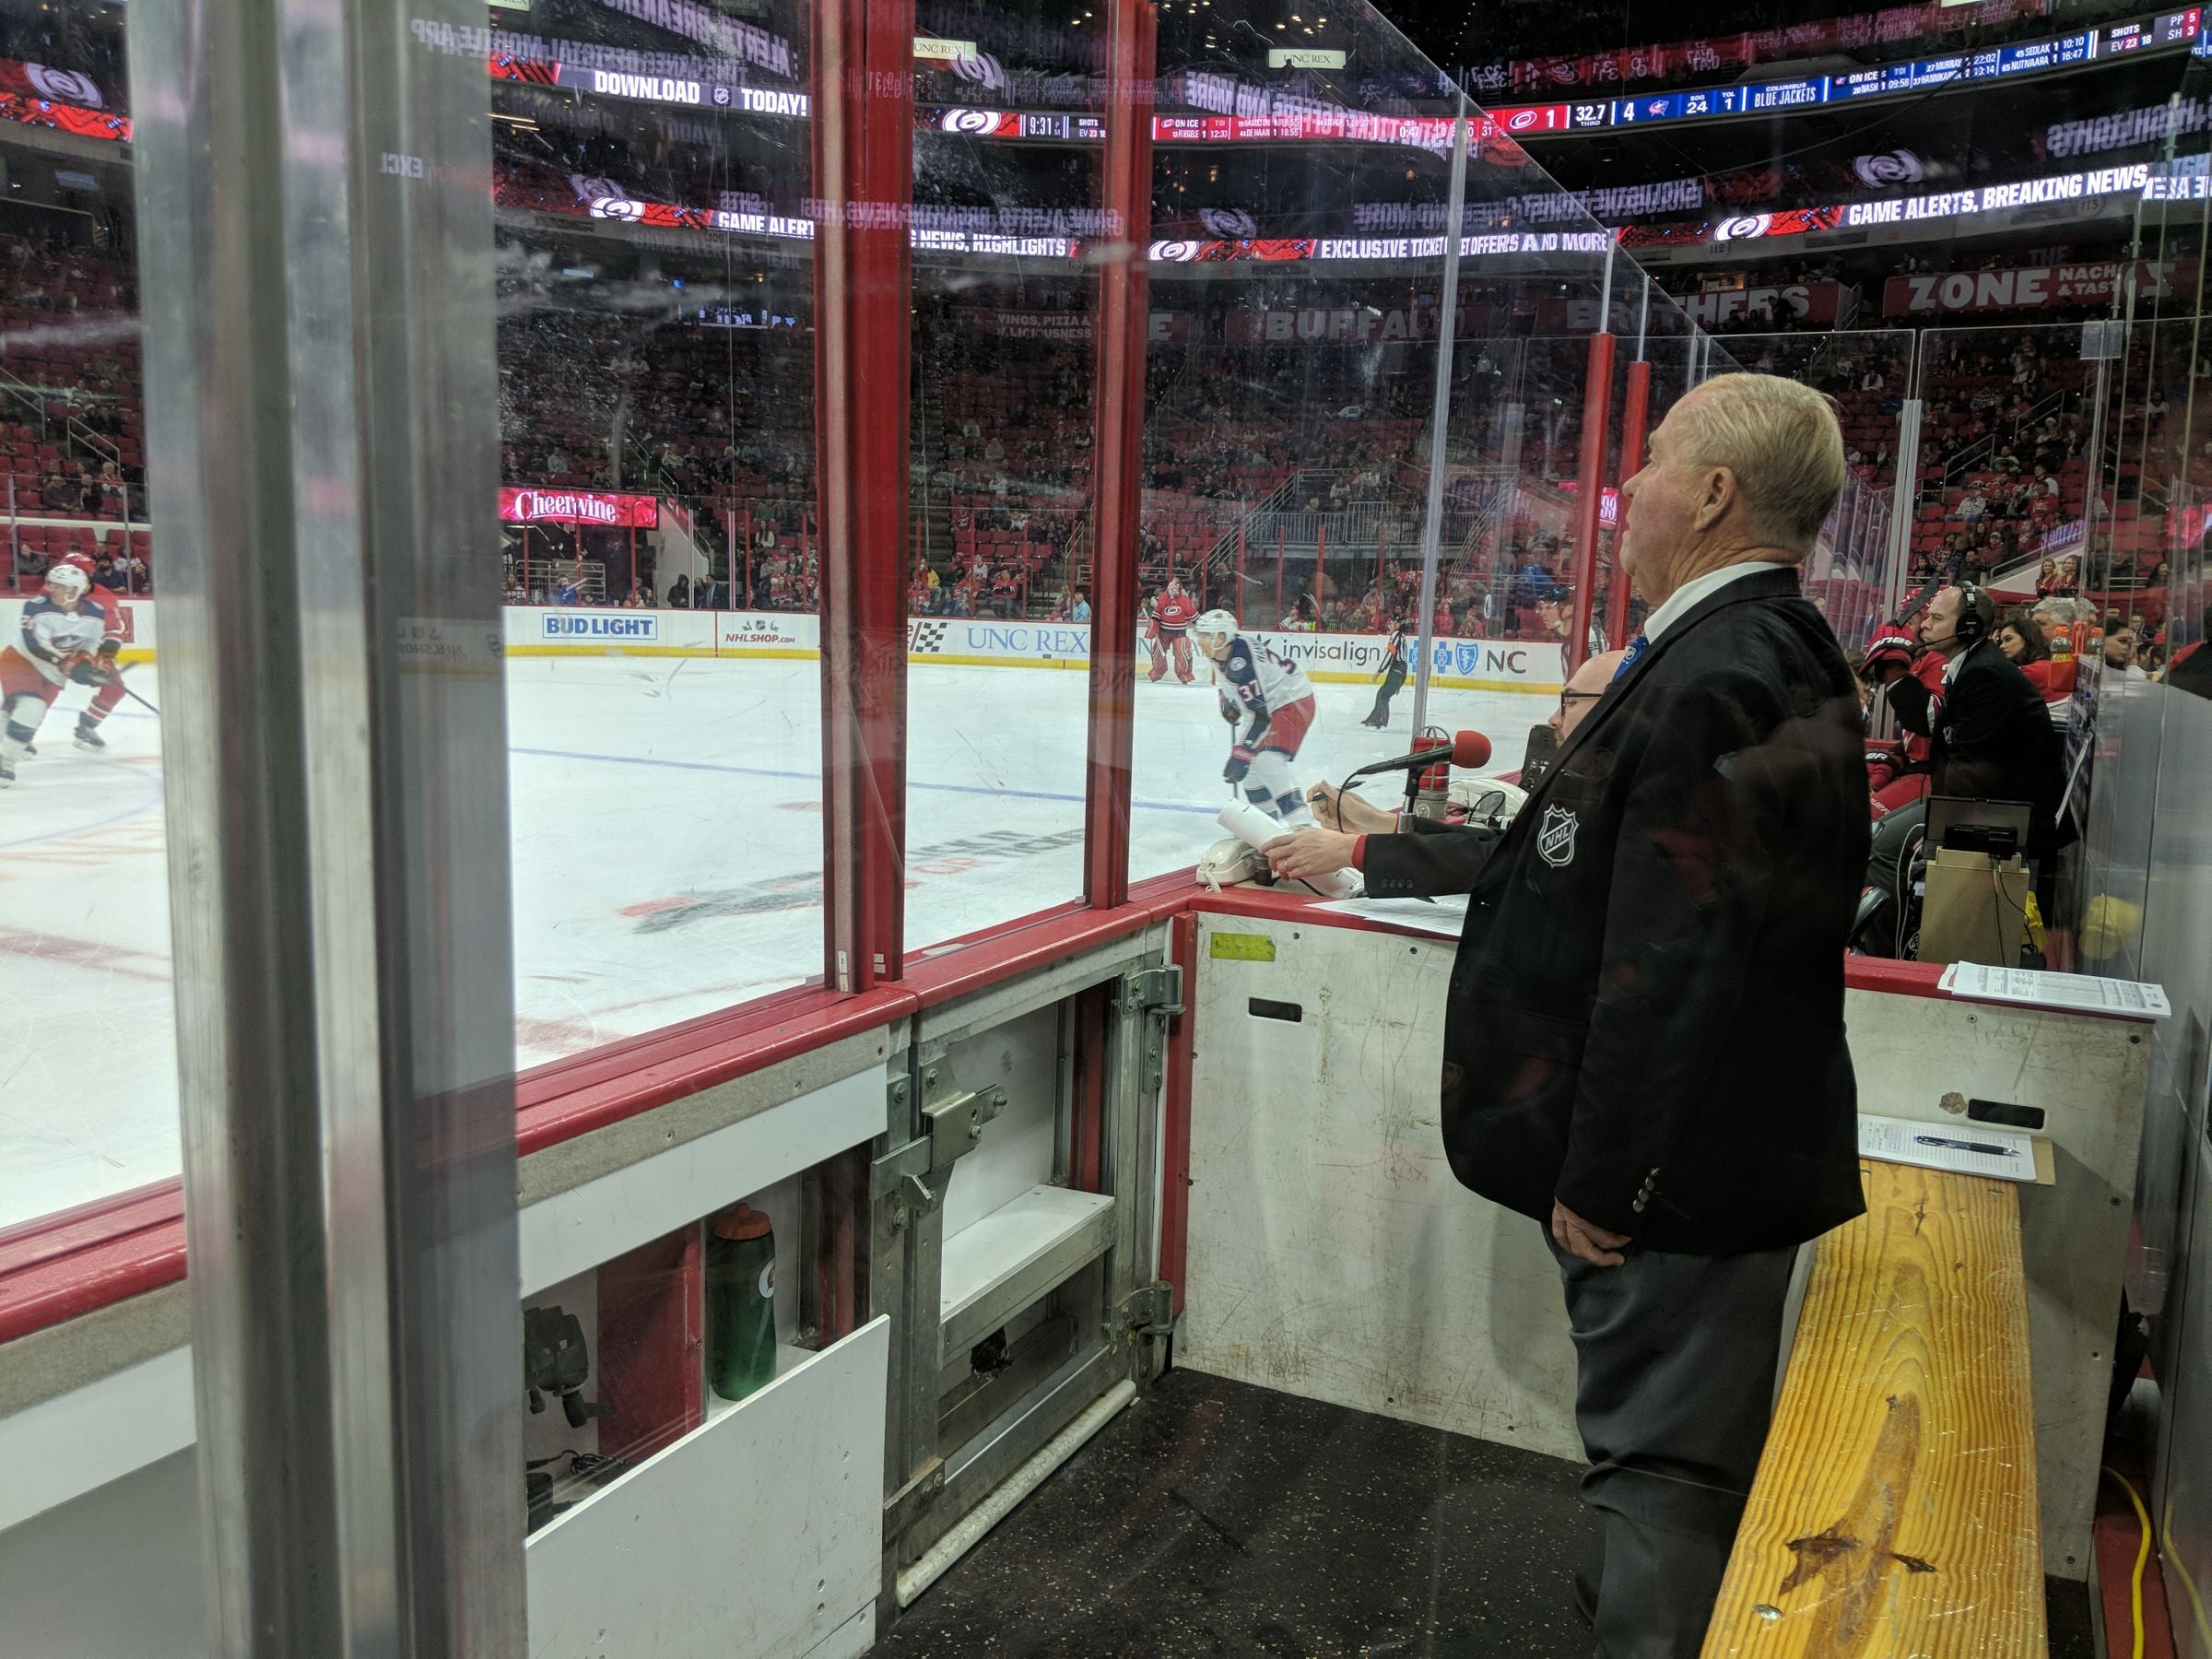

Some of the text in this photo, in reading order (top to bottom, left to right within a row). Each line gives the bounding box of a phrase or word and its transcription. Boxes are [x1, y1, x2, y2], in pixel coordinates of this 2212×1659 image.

[2171, 12, 2196, 27] PP 5
[2112, 25, 2140, 38] SHOTS
[2168, 26, 2194, 40] SH 3
[914, 43, 938, 53] UNC
[2016, 37, 2084, 58] 45 SEDLAK 1 10:10
[2111, 34, 2152, 52] EV 23 18
[1284, 53, 1331, 65] UNC REX
[1925, 53, 1996, 73] 27 MURRAY 22:02
[2002, 63, 2011, 72] 65
[2053, 54, 2058, 64] 1
[2062, 49, 2083, 61] 16:47
[1849, 73, 1863, 84] ON
[1864, 71, 1878, 82] ICE
[1894, 67, 1906, 76] TOI
[1912, 77, 1922, 86] 37
[595, 71, 700, 104] DOWNLOAD
[741, 88, 806, 116] TODAY!
[1765, 82, 1807, 92] COLUMBUS
[1861, 82, 1878, 93] NASH
[1881, 82, 1886, 90] 1
[1888, 78, 1910, 89] 09:58
[1724, 99, 1732, 110] 1
[1754, 87, 1817, 108] BLUE JACKETS
[1575, 105, 1606, 122] 32.7
[1623, 102, 1635, 122] 4
[1686, 100, 1707, 113] 24
[1030, 117, 1052, 135] 9:31
[1547, 110, 1555, 128] 1
[1079, 129, 1088, 137] EV
[1089, 129, 1098, 137] 23
[1202, 130, 1206, 138] 1
[1281, 128, 1299, 136] 18:55
[1400, 126, 1418, 138] 0:47
[1481, 126, 1492, 136] 31
[1849, 200, 1901, 226] GAME
[1904, 190, 1979, 220] ALERTS,
[1983, 175, 2084, 211] BREAKING
[2085, 164, 2147, 194] NEWS
[2080, 199, 2099, 211] 113
[719, 212, 765, 231] GAME
[922, 230, 969, 253] NEWS,
[973, 233, 1066, 256] HIGHLIGHTS
[1322, 240, 1407, 259] EXCLUSIVE
[1562, 232, 1607, 252] MORE
[1711, 242, 1725, 254] 112
[2059, 264, 2121, 281] NACH
[1909, 268, 2052, 310] ZONE
[2057, 284, 2069, 296] &
[1042, 314, 1079, 326] PIZZA
[515, 491, 617, 523] Cheerwine
[547, 618, 653, 636] BUD LIGHT
[967, 627, 1089, 653] UNC REX
[1283, 639, 1381, 670] invisalign
[1486, 650, 1527, 675] NC
[1239, 679, 1262, 702] 37
[1545, 825, 1571, 851] NHL
